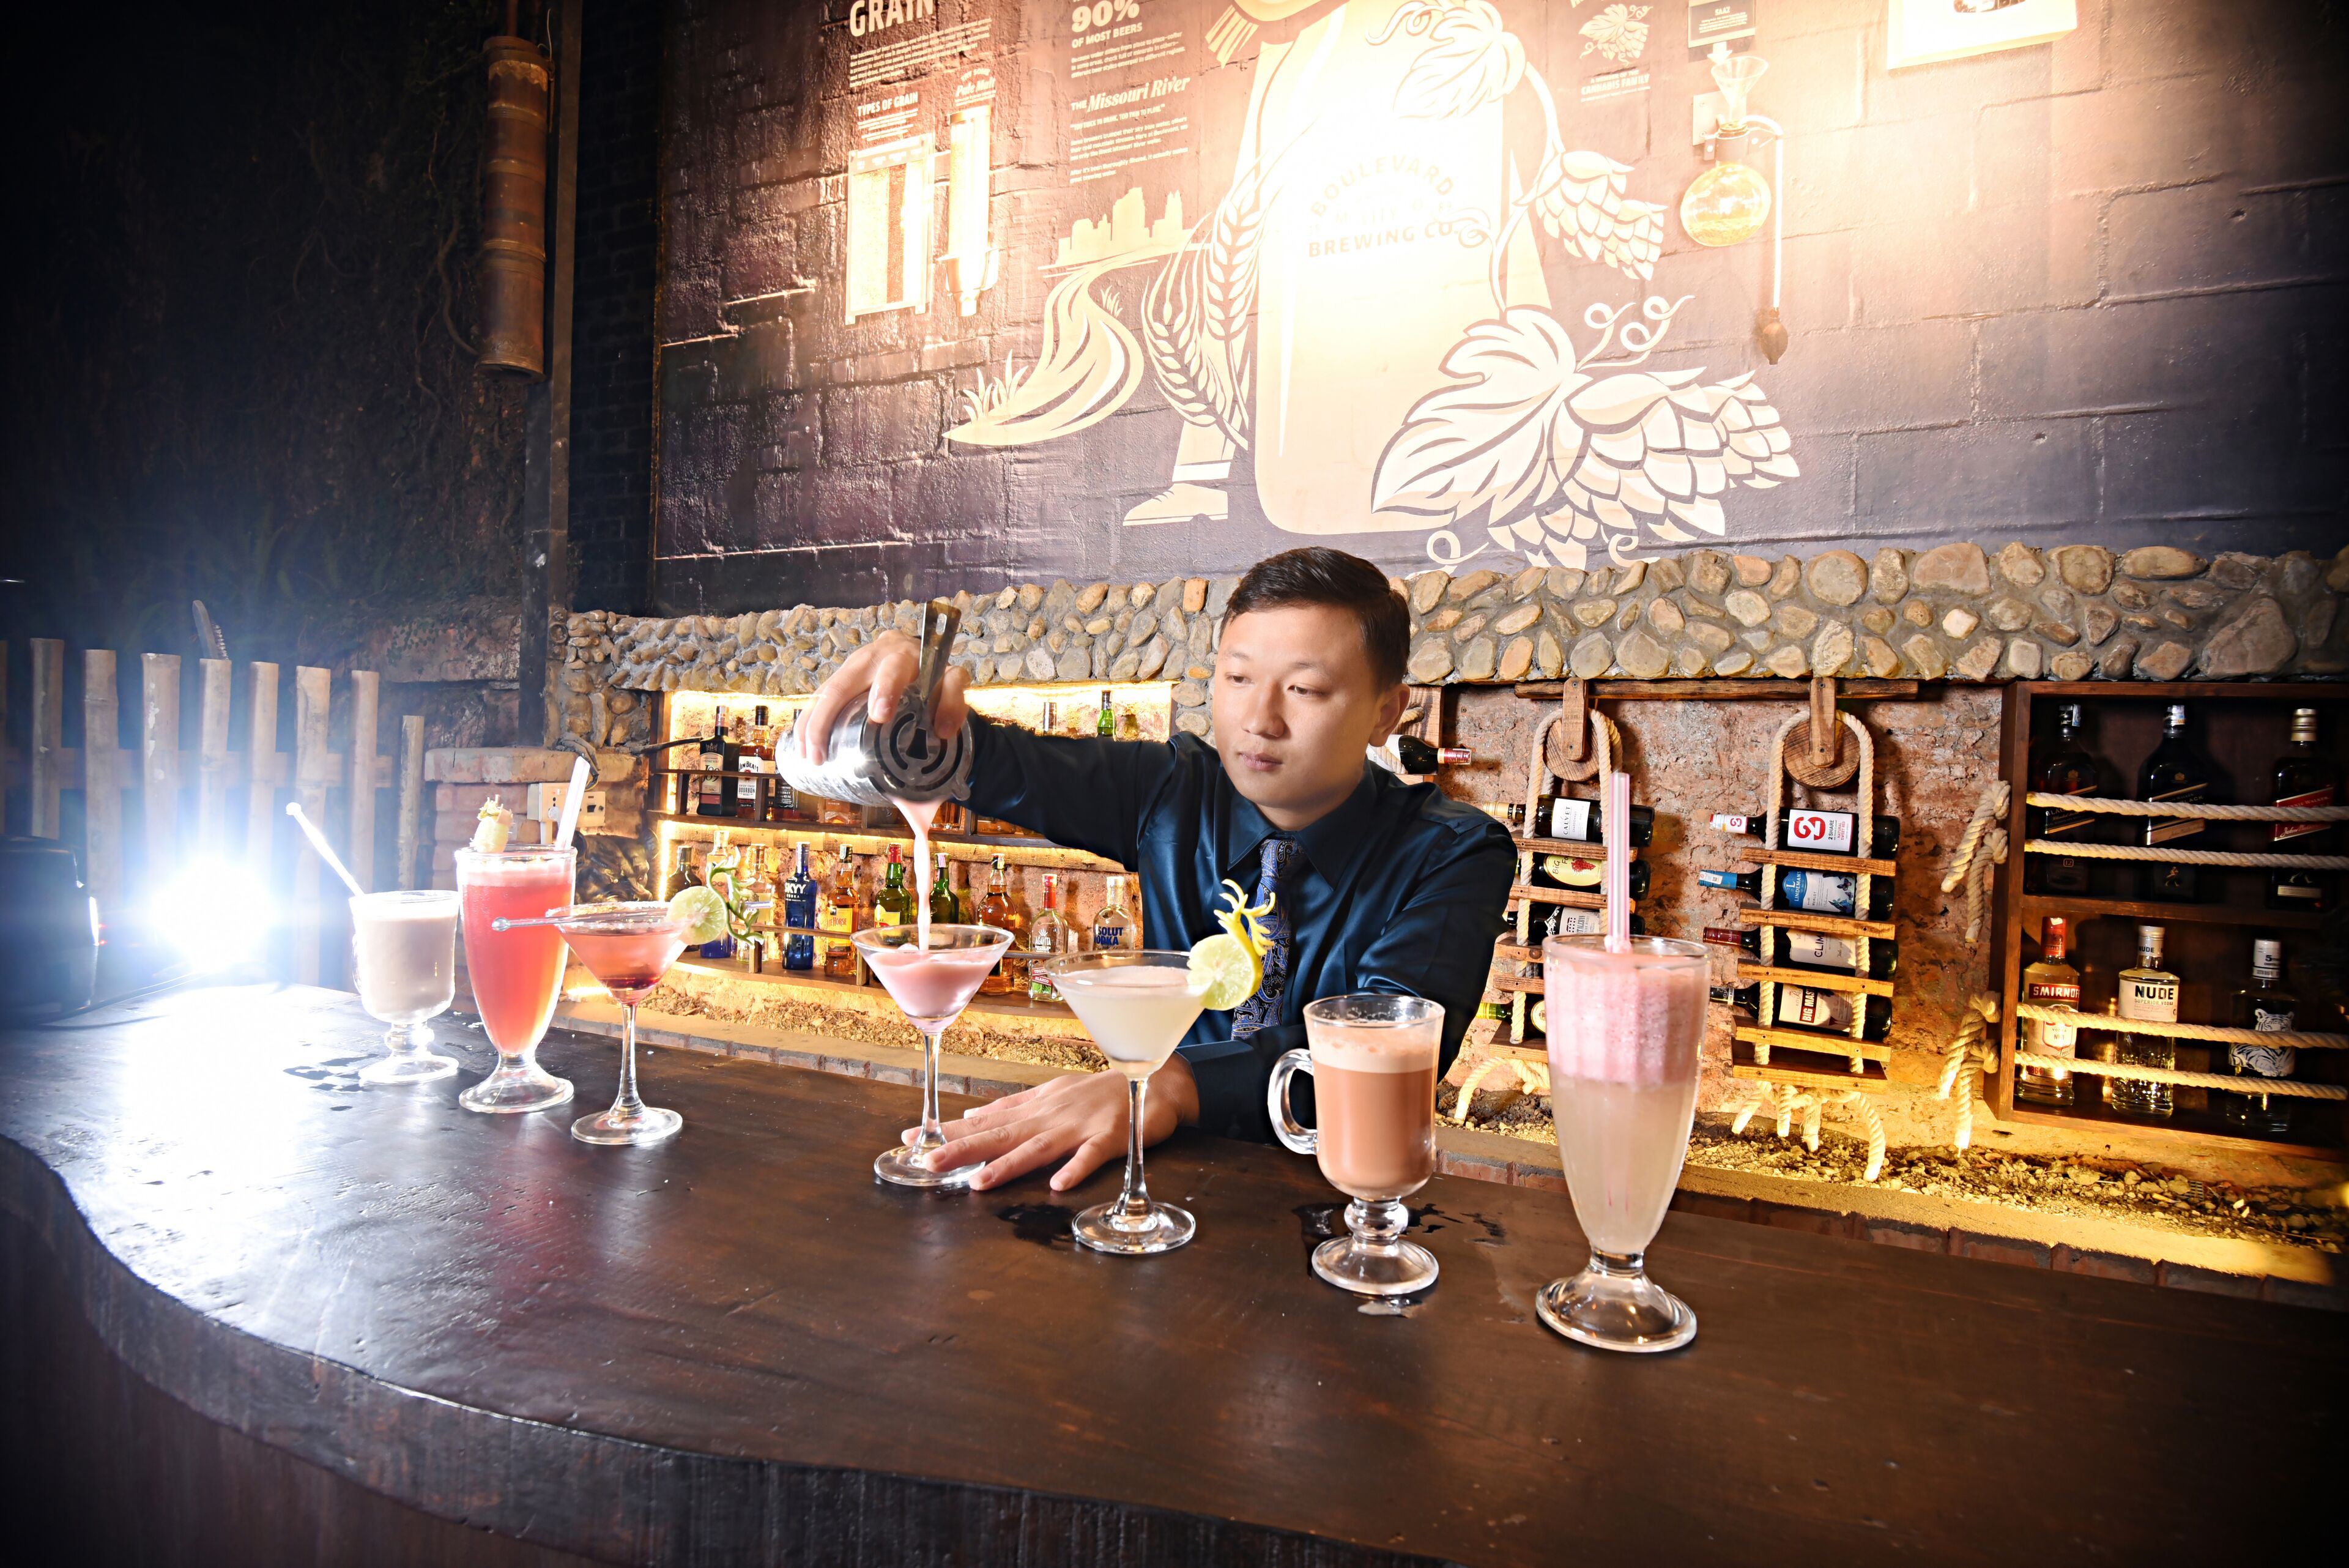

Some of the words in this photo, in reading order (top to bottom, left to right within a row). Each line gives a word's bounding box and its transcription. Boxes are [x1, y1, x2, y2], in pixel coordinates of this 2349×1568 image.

[1072, 0, 1140, 32] 90%
[1715, 6, 1730, 16] SAAZ
[1072, 37, 1084, 48] OF
[1086, 31, 1111, 45] MOST
[1113, 22, 1143, 38] BEERS
[976, 77, 996, 91] Malt
[1581, 77, 1620, 95] CANNABIS
[1621, 74, 1650, 87] FAMILY
[1071, 100, 1087, 111] THE
[1087, 82, 1149, 113] Missouri
[1151, 76, 1191, 98] River
[857, 102, 880, 117] TYPES
[882, 98, 892, 111] OF
[894, 92, 918, 108] GRAIN
[1311, 154, 1453, 218] BOULEVARD
[1308, 226, 1415, 258] BREWING
[2046, 807, 2066, 817] BLA
[785, 882, 806, 894] SKYY
[833, 918, 847, 927] HORSE
[1094, 927, 1123, 936] SOLUT
[1035, 937, 1052, 946] AGAVITA
[2135, 985, 2174, 1000] NUDE
[1802, 1008, 1813, 1021] BIG
